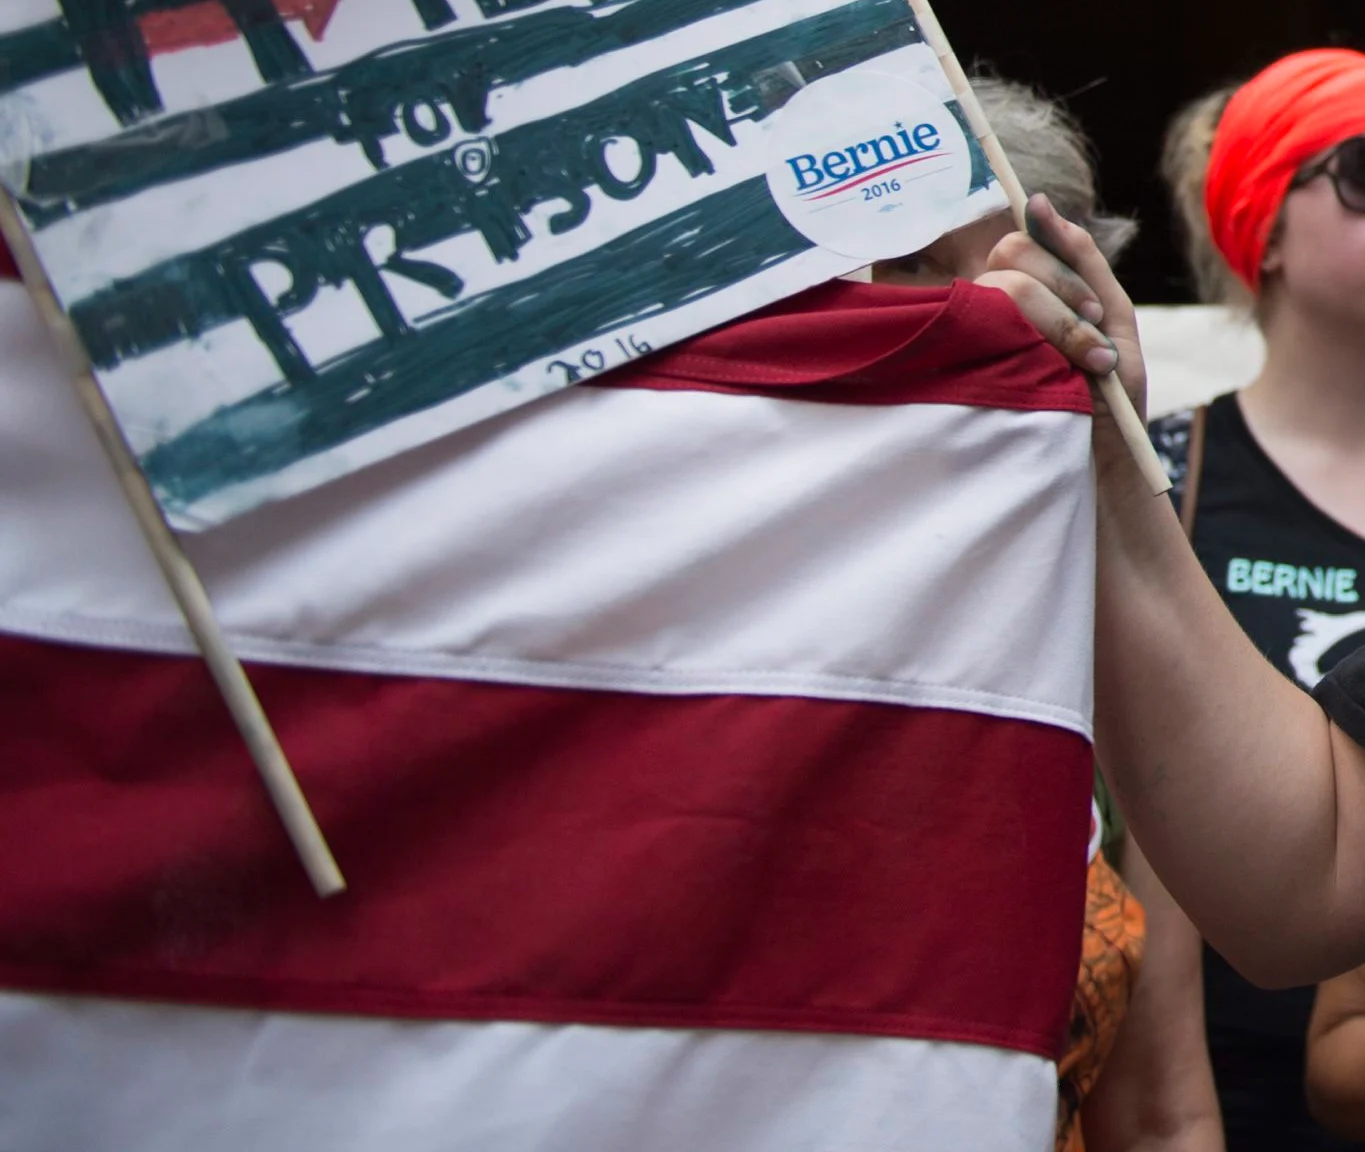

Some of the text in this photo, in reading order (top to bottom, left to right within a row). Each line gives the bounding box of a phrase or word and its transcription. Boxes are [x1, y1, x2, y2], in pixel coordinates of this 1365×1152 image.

[784, 119, 942, 192] Bernie
[860, 178, 902, 201] 2016
[546, 333, 653, 383] 2016
[1225, 556, 1359, 604] BERNIE
